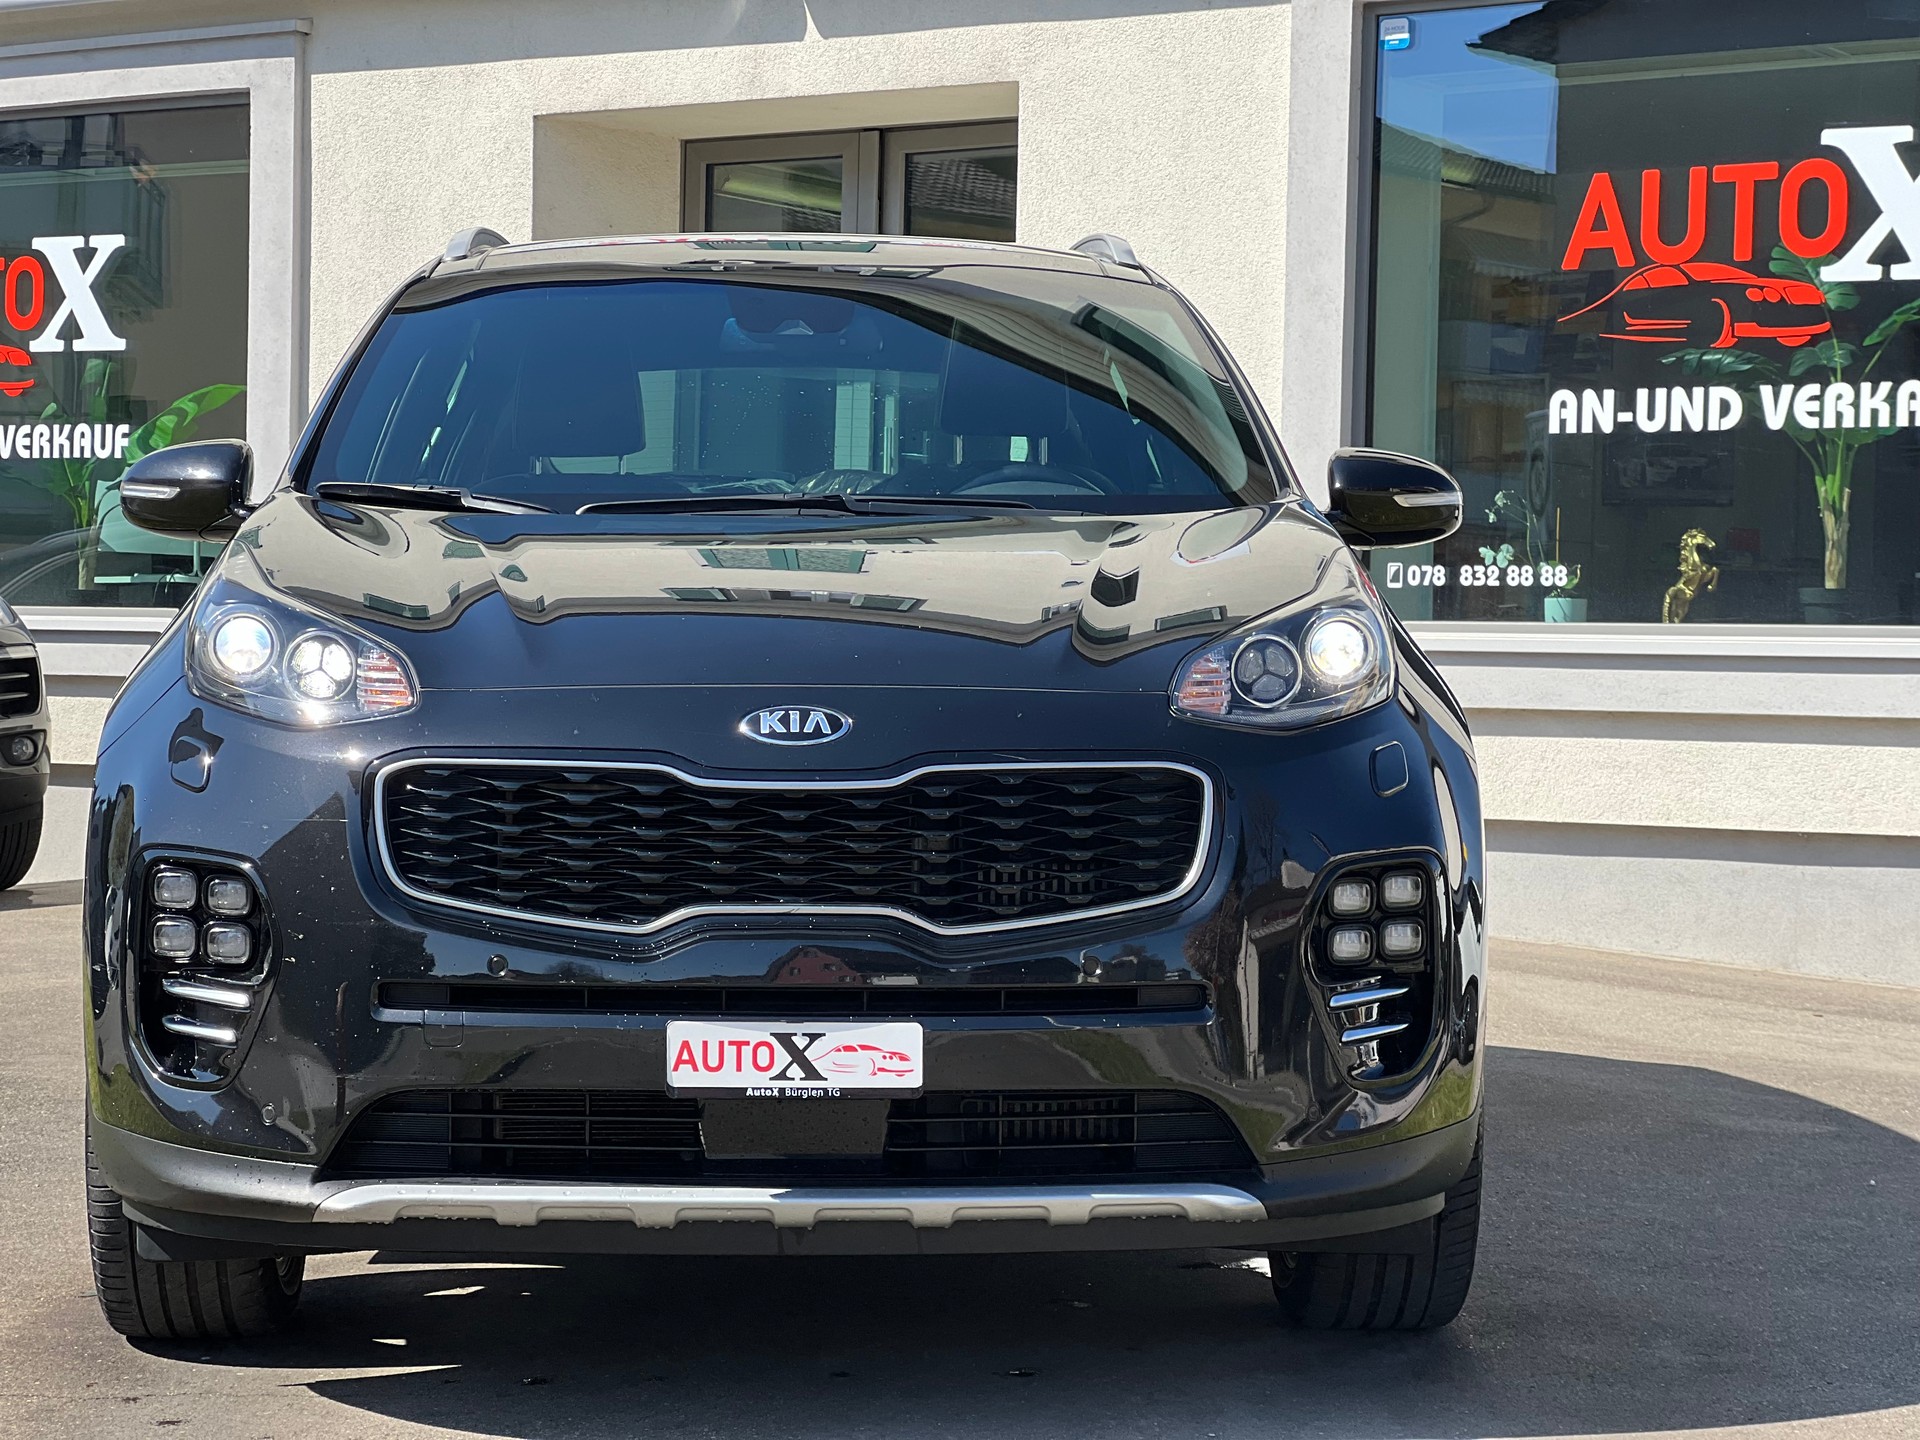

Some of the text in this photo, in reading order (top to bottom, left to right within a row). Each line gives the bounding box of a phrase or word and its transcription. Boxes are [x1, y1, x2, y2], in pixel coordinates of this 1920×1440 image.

[1561, 124, 1920, 282] AUTOX
[0, 234, 126, 352] OX
[1548, 385, 1743, 434] AN-UND
[0, 423, 130, 459] VERKAUF
[1407, 565, 1568, 587] 078 832 88 88
[759, 710, 831, 734] KIA
[672, 1032, 828, 1082] AUTOX
[746, 1087, 841, 1098] AutoX Bürglen TG
